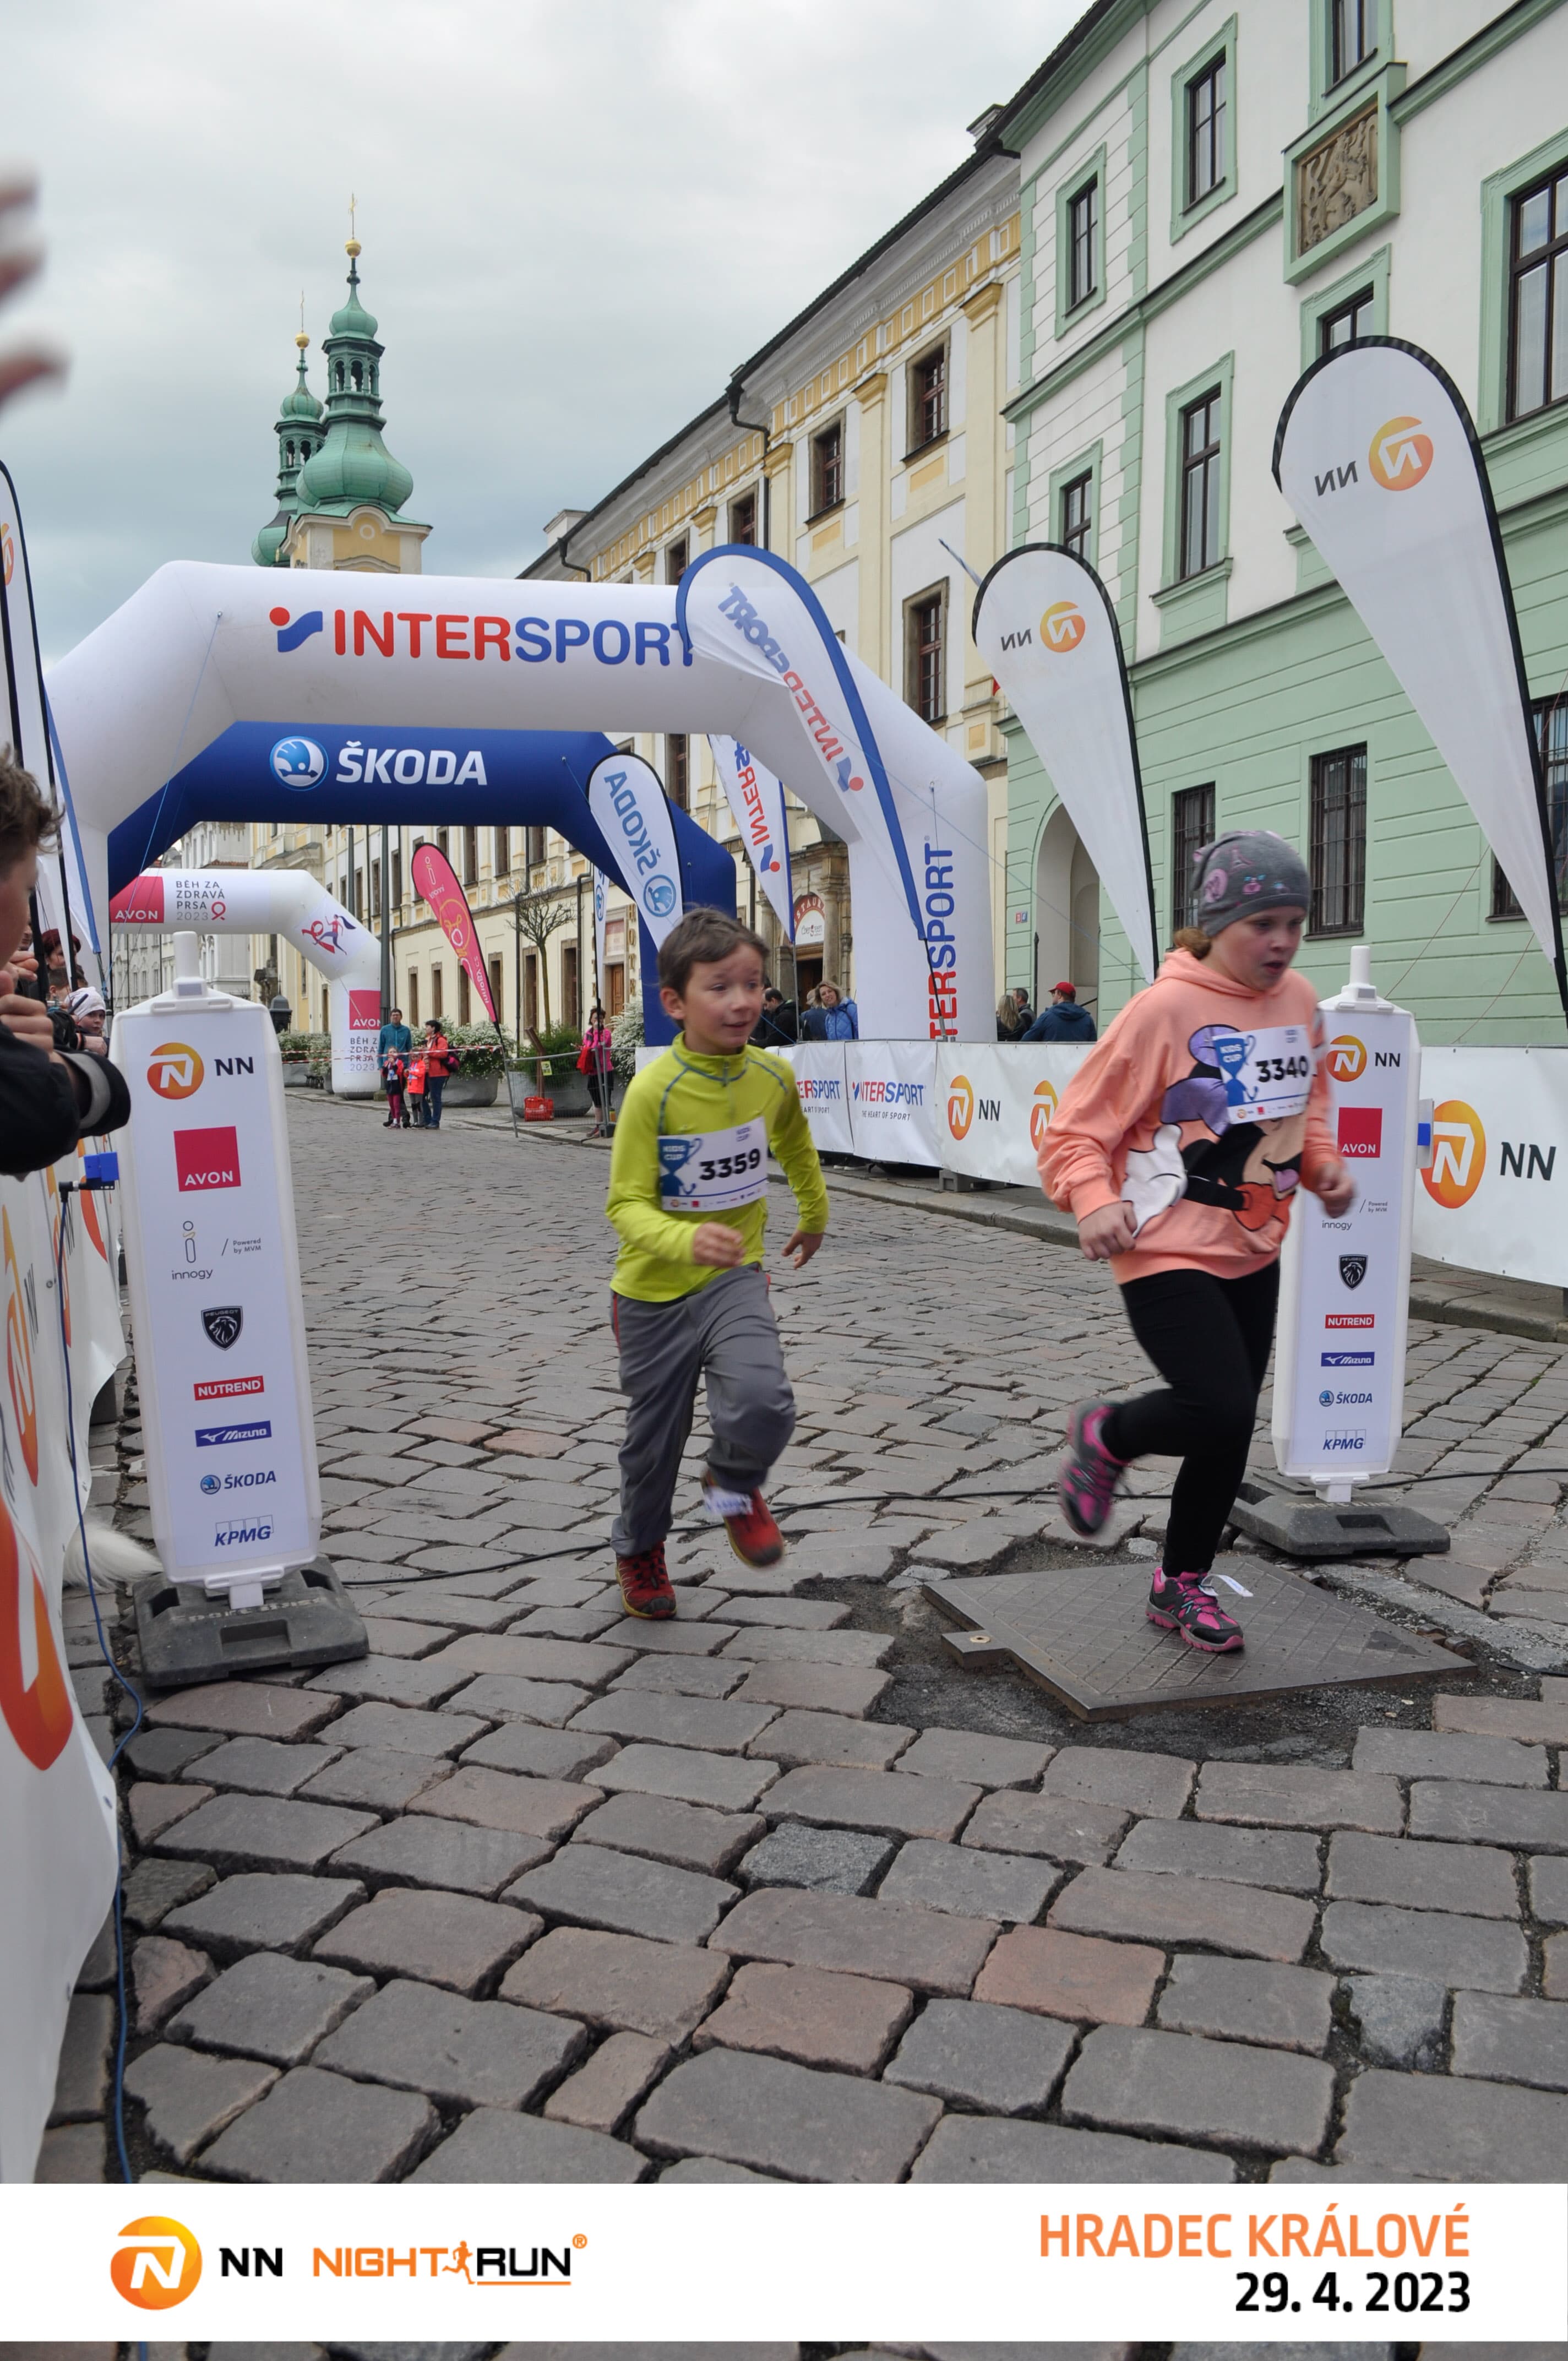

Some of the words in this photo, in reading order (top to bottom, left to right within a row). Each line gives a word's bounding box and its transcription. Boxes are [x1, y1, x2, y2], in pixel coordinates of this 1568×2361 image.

[336, 740, 487, 785] ŠKODA
[176, 880, 199, 888] BĚH
[176, 889, 225, 899] ZDRAVÁ
[177, 901, 207, 909] PRSA
[115, 910, 158, 920] AVON
[177, 911, 208, 921] 2023
[924, 842, 958, 1040] TERSPORT
[1375, 1052, 1401, 1067] NN
[214, 1057, 254, 1076] NN
[1255, 1055, 1309, 1082] 3340
[797, 1080, 840, 1099] TERSPORT
[890, 1112, 911, 1121] SPORT
[978, 1099, 1000, 1122] NN
[1341, 1143, 1376, 1154] AVON
[699, 1148, 760, 1181] 3359
[1500, 1141, 1556, 1181] NN
[185, 1171, 233, 1185] AVON
[1322, 1220, 1352, 1231] innogy
[233, 1238, 261, 1246] Powered
[171, 1269, 213, 1280] innogy
[1328, 1317, 1373, 1325] NUTREND
[198, 1380, 261, 1397] NUTREND
[1336, 1392, 1373, 1404] ŠKODA
[1322, 1438, 1364, 1450] KPMG
[224, 1471, 276, 1489] ŠKODA
[215, 1525, 272, 1547] KPMG
